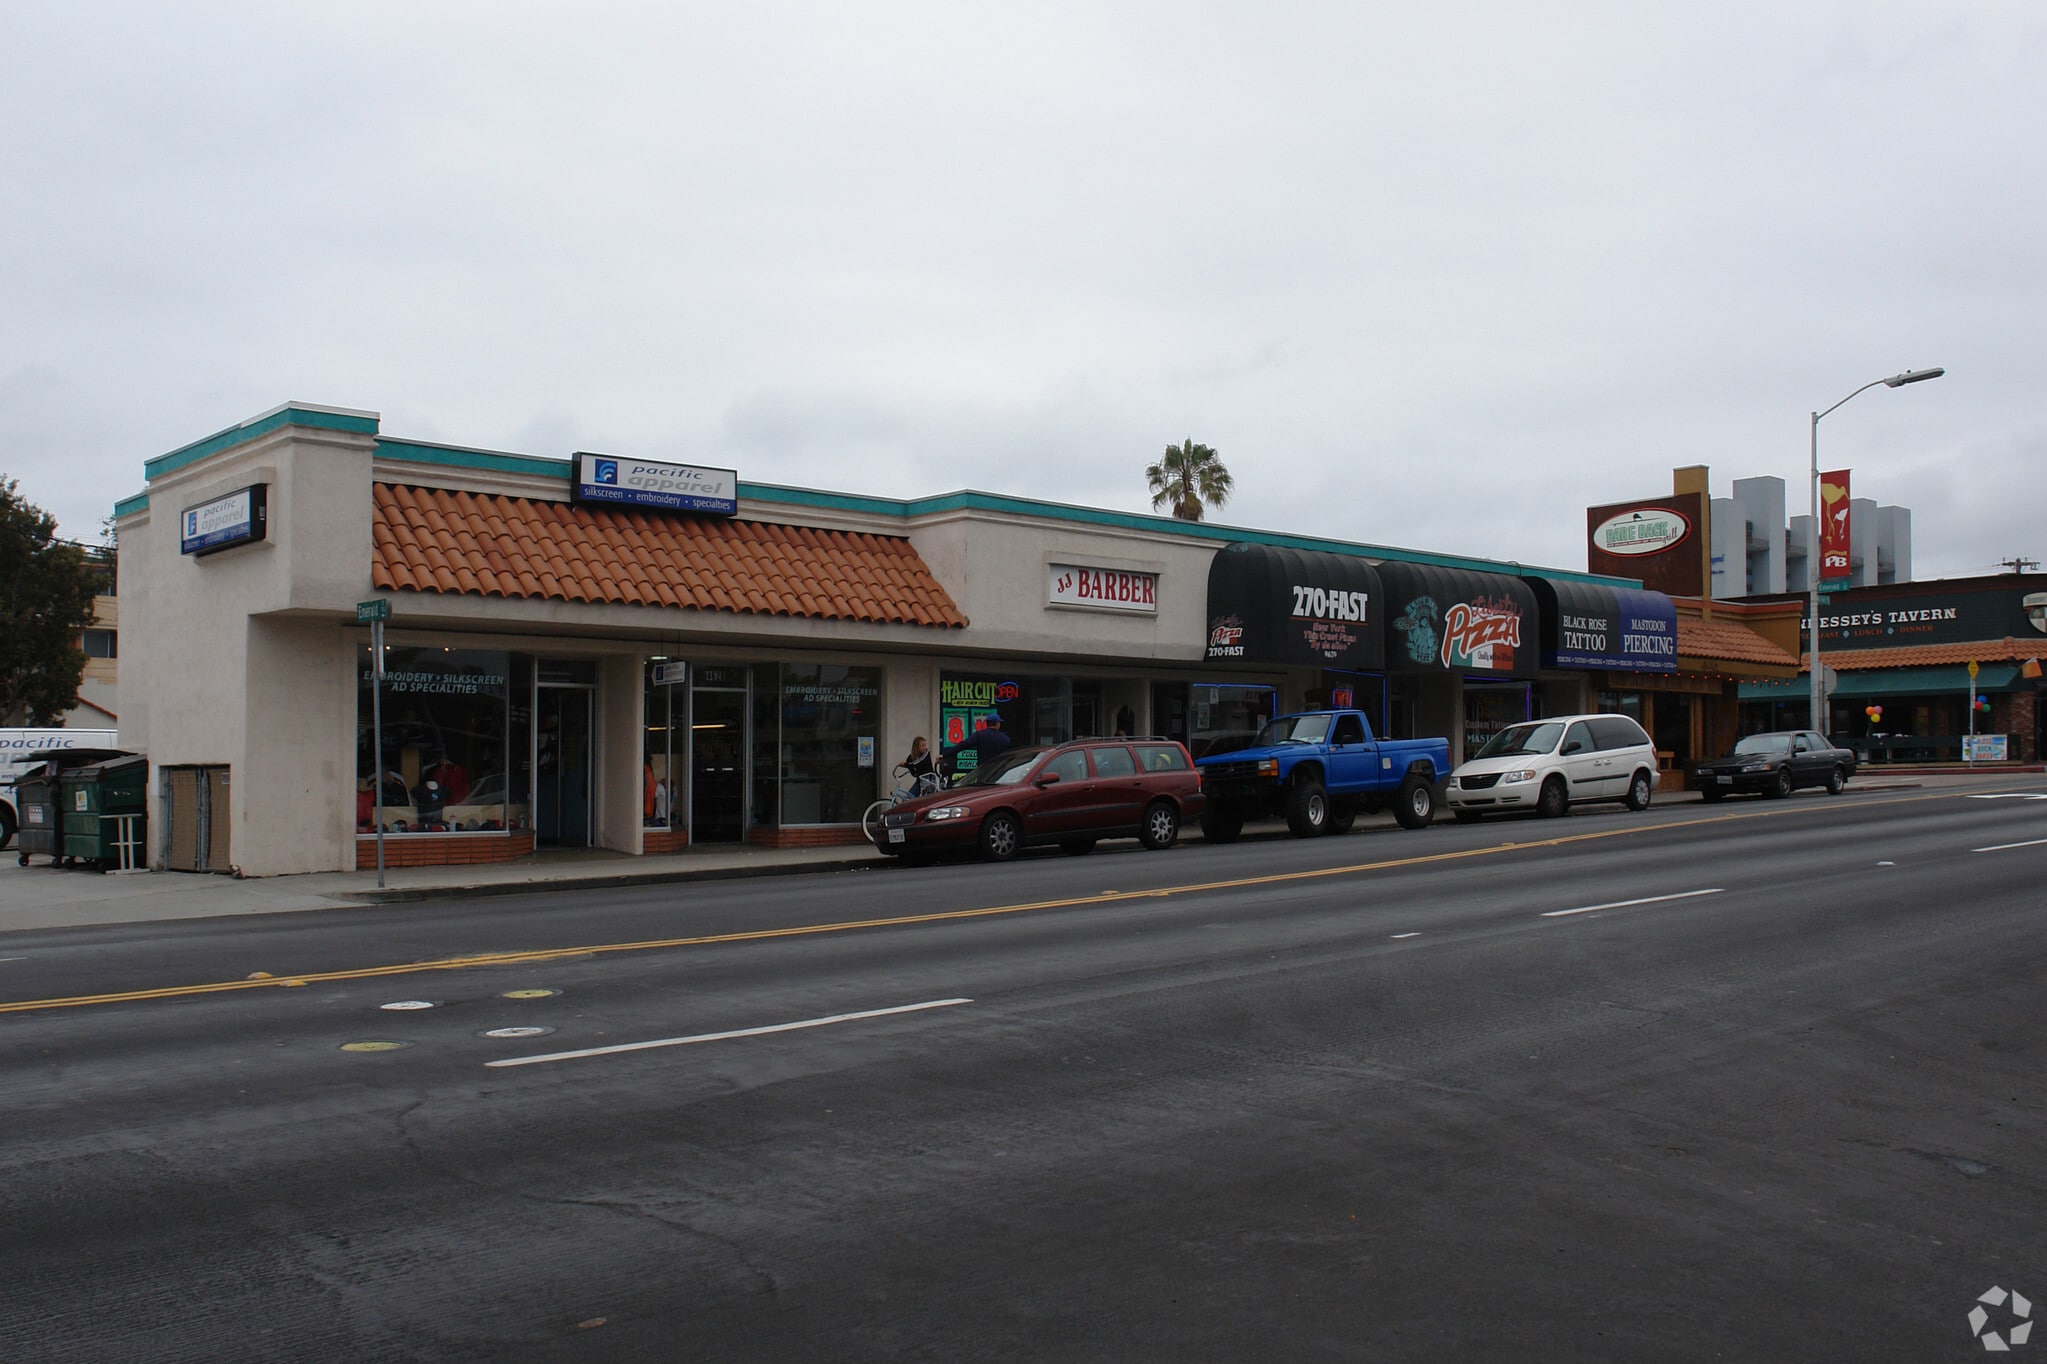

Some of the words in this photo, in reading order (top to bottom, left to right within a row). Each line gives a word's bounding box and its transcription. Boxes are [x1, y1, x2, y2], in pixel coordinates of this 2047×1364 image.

[632, 466, 704, 480] pacific
[628, 476, 722, 494] apparel
[584, 487, 623, 499] silkscreen
[635, 492, 681, 507] embroidery
[693, 499, 730, 510] specialties
[203, 500, 236, 519] pacific
[201, 506, 244, 531] apparel
[1606, 525, 1637, 544] BARE
[1638, 521, 1668, 540] BACK
[1825, 556, 1847, 568] PB
[1057, 573, 1072, 593] JJ
[1078, 570, 1154, 604] BARBER
[1563, 615, 1587, 630] BLACK
[1588, 617, 1608, 631] ROSE
[1888, 608, 1957, 623] TAVERN
[1631, 619, 1667, 632] MASTODON
[1901, 625, 1934, 633] DINNER
[1564, 631, 1606, 651] TATTOO
[1623, 635, 1674, 655] PIERCING
[442, 673, 504, 685] SILKSCREEN
[391, 682, 407, 692] AD
[410, 683, 478, 694] SPECIALITIES
[786, 685, 831, 695] EMBROIDERY
[836, 687, 878, 696] SILKSCREEN
[996, 685, 1019, 699] OPEN
[804, 694, 814, 703] AD
[816, 695, 860, 704] SPECIALITIES
[948, 718, 963, 744] 8
[0, 737, 74, 749] pacific
